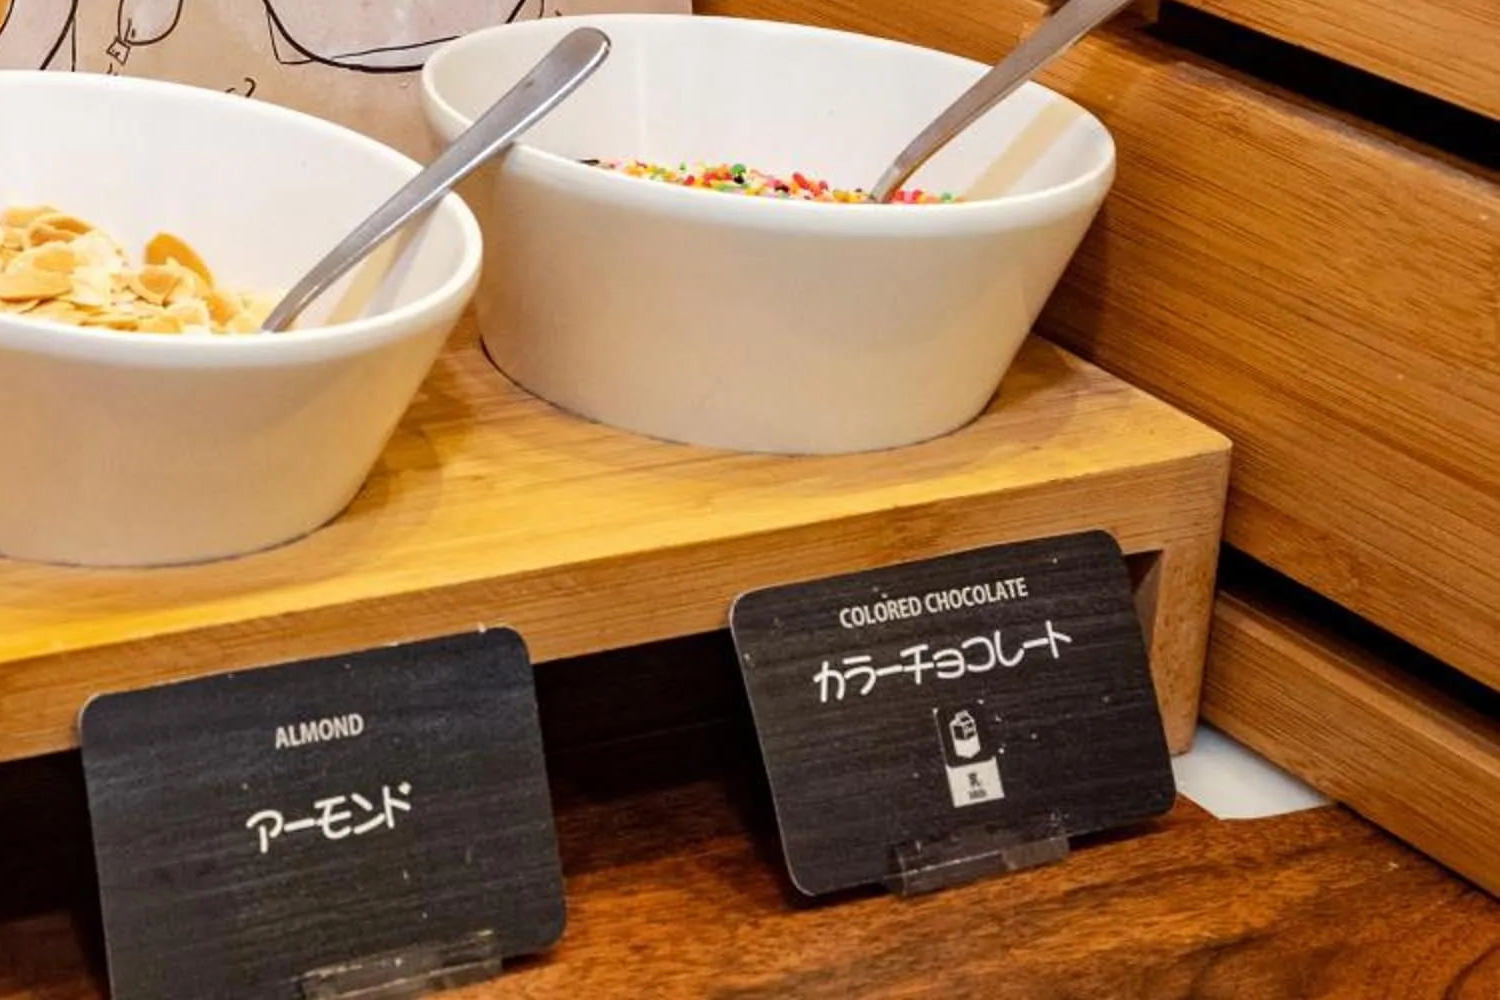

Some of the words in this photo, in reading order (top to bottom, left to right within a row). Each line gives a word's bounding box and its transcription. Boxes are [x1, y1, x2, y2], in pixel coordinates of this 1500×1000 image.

[839, 596, 922, 628] COLORED
[925, 576, 1029, 613] CHOCOLATE
[813, 620, 1073, 703] カラーチョコレート
[274, 712, 365, 749] ALMOND
[245, 782, 412, 854] アーモンド
